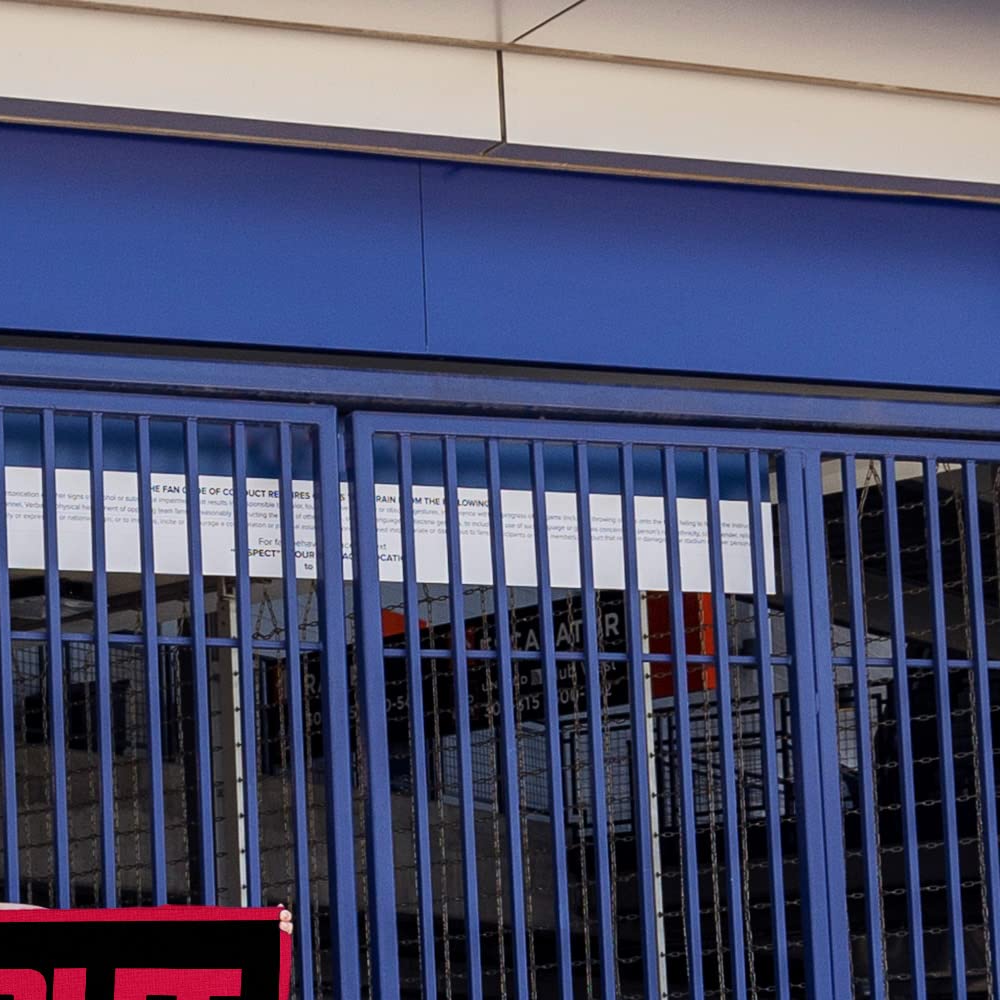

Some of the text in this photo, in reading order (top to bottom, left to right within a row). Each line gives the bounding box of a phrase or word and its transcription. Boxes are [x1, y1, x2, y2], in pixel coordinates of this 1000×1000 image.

[162, 485, 180, 494] FAN
[208, 487, 221, 496] OF
[424, 497, 441, 506] THE
[258, 538, 273, 546] For
[294, 550, 315, 559] OUR
